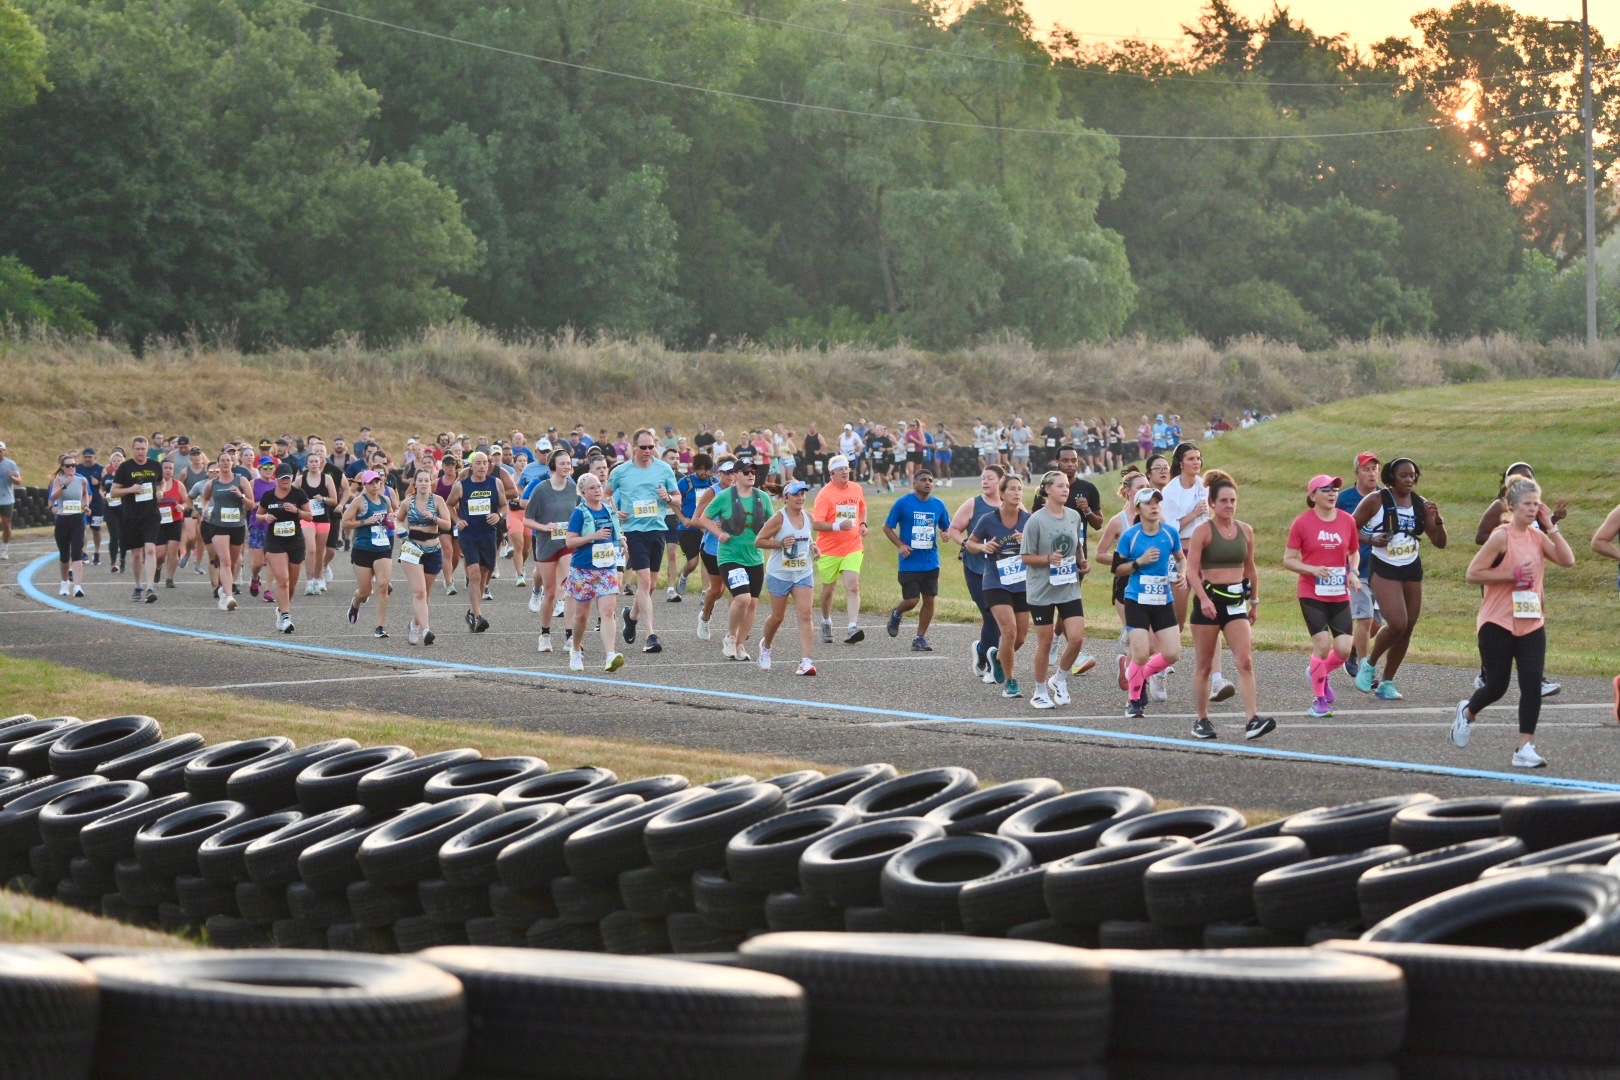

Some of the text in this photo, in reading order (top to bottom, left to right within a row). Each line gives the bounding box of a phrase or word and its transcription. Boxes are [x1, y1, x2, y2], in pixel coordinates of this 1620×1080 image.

[637, 506, 655, 515] 3811
[915, 533, 931, 541] 945
[783, 559, 805, 568] 4516
[1003, 563, 1022, 575] 837
[1056, 566, 1073, 576] 103
[731, 574, 748, 584] 462
[1144, 584, 1165, 595] 939
